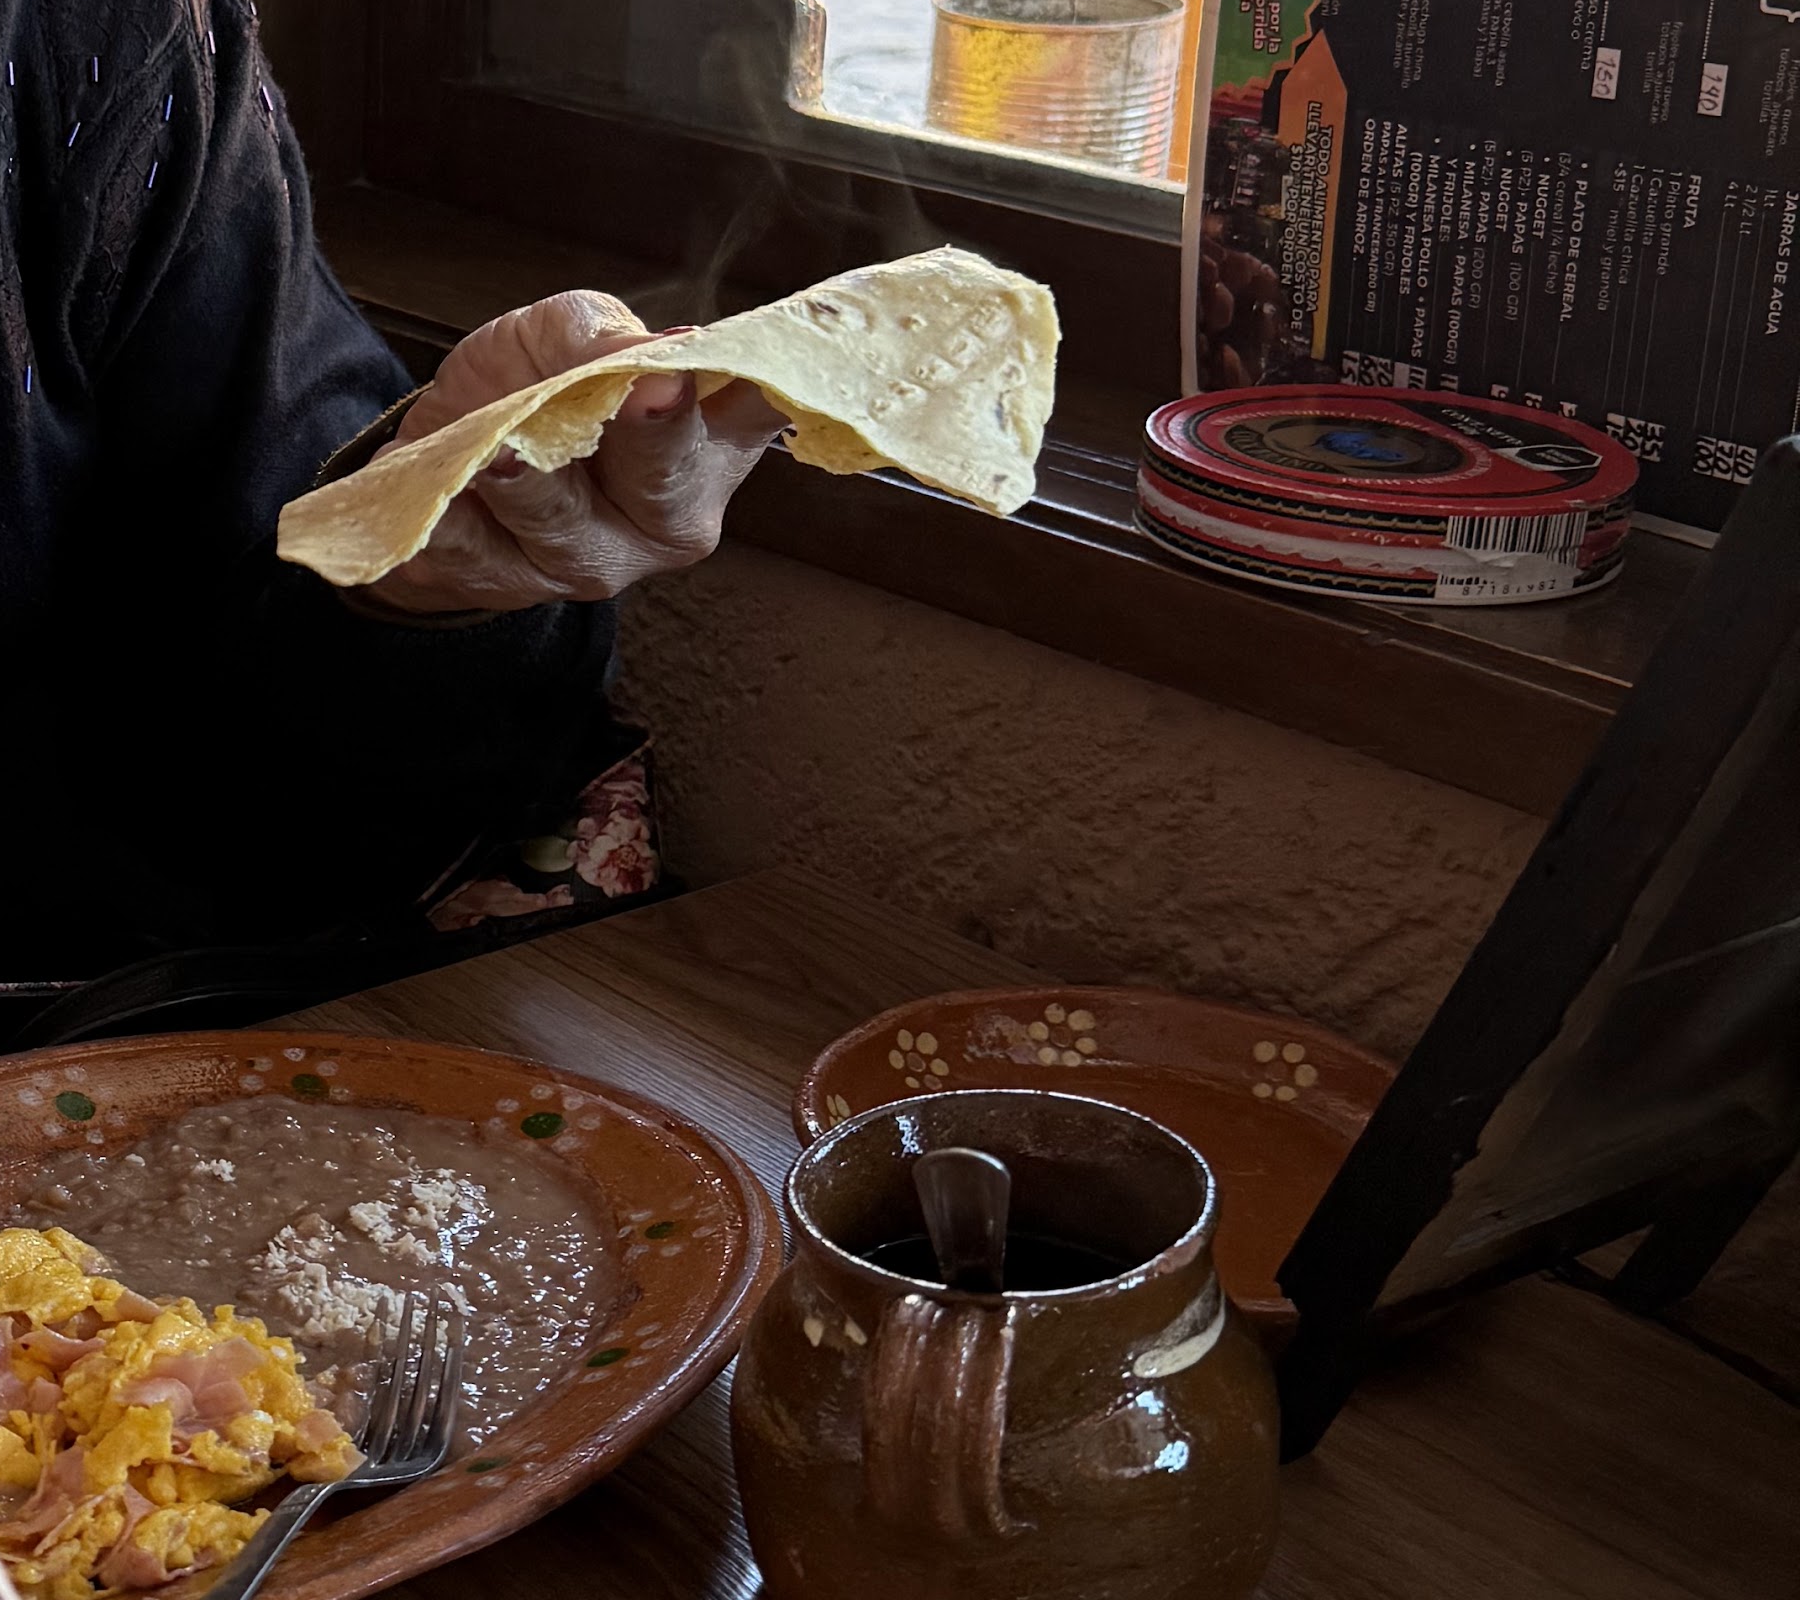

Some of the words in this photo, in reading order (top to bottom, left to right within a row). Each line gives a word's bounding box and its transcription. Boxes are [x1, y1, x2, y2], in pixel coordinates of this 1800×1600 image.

[1263, 0, 1282, 32] por
[1266, 36, 1282, 53] la
[1493, 50, 1508, 87] asada
[1698, 73, 1723, 112] 140
[1288, 143, 1305, 171] $10
[1300, 101, 1323, 168] LLEVAR
[1313, 126, 1334, 175] TODO
[1358, 118, 1377, 173] ORDEN
[1377, 121, 1393, 164] PAPAS
[1390, 122, 1408, 177] ALITAS
[1482, 138, 1497, 153] (5
[1519, 149, 1534, 163] (5
[1376, 166, 1387, 176] A
[1403, 151, 1424, 208] (100GR)
[1444, 157, 1458, 168] Y
[1726, 180, 1739, 191] 4
[1283, 187, 1301, 224] POR
[1296, 169, 1315, 218] TIENE
[1356, 176, 1371, 198] DE
[1374, 178, 1386, 195] LA
[1420, 154, 1442, 233] MILANESA
[1436, 171, 1457, 243] FRIJOLES
[1455, 161, 1477, 241] MILANESA
[1493, 167, 1513, 232] NUGGET
[1530, 173, 1550, 239] NUGGET
[1550, 180, 1569, 225] cereal
[1569, 179, 1588, 232] PLATO
[1621, 172, 1644, 242] Cazuelita
[1662, 180, 1681, 220] Plato
[1681, 174, 1702, 229] FRUTA
[1722, 193, 1738, 209] Lt
[1741, 197, 1757, 218] 1/2
[1744, 183, 1757, 193] 2
[1294, 221, 1311, 246] UN
[1304, 177, 1329, 264] ALIMENTO
[1404, 211, 1417, 222] Y
[1473, 190, 1491, 243] PAPAS
[1510, 201, 1528, 254] PAPAS
[1641, 176, 1663, 246] Cazuelita
[1739, 221, 1753, 234] Lt
[1777, 190, 1800, 257] JARRAS
[1277, 225, 1298, 285] ORDEN
[1396, 225, 1417, 295] FRIJOLES
[1548, 227, 1564, 246] 1/4
[1566, 236, 1581, 258] DE
[1654, 222, 1674, 276] grande
[1288, 249, 1309, 305] COSTO
[1414, 237, 1433, 288] POLLO
[1448, 254, 1467, 306] PAPAS
[1594, 256, 1614, 312] granola
[1617, 244, 1634, 285] chica
[1772, 260, 1787, 284] DE
[1302, 266, 1322, 312] PARA
[1363, 291, 1377, 313] GR)
[1558, 261, 1578, 323] CEREAL
[1763, 286, 1784, 336] AGUA
[1289, 308, 1304, 330] DE
[1408, 306, 1427, 358] PAPAS
[1441, 308, 1462, 364] (100GR)
[1733, 447, 1755, 479] 40
